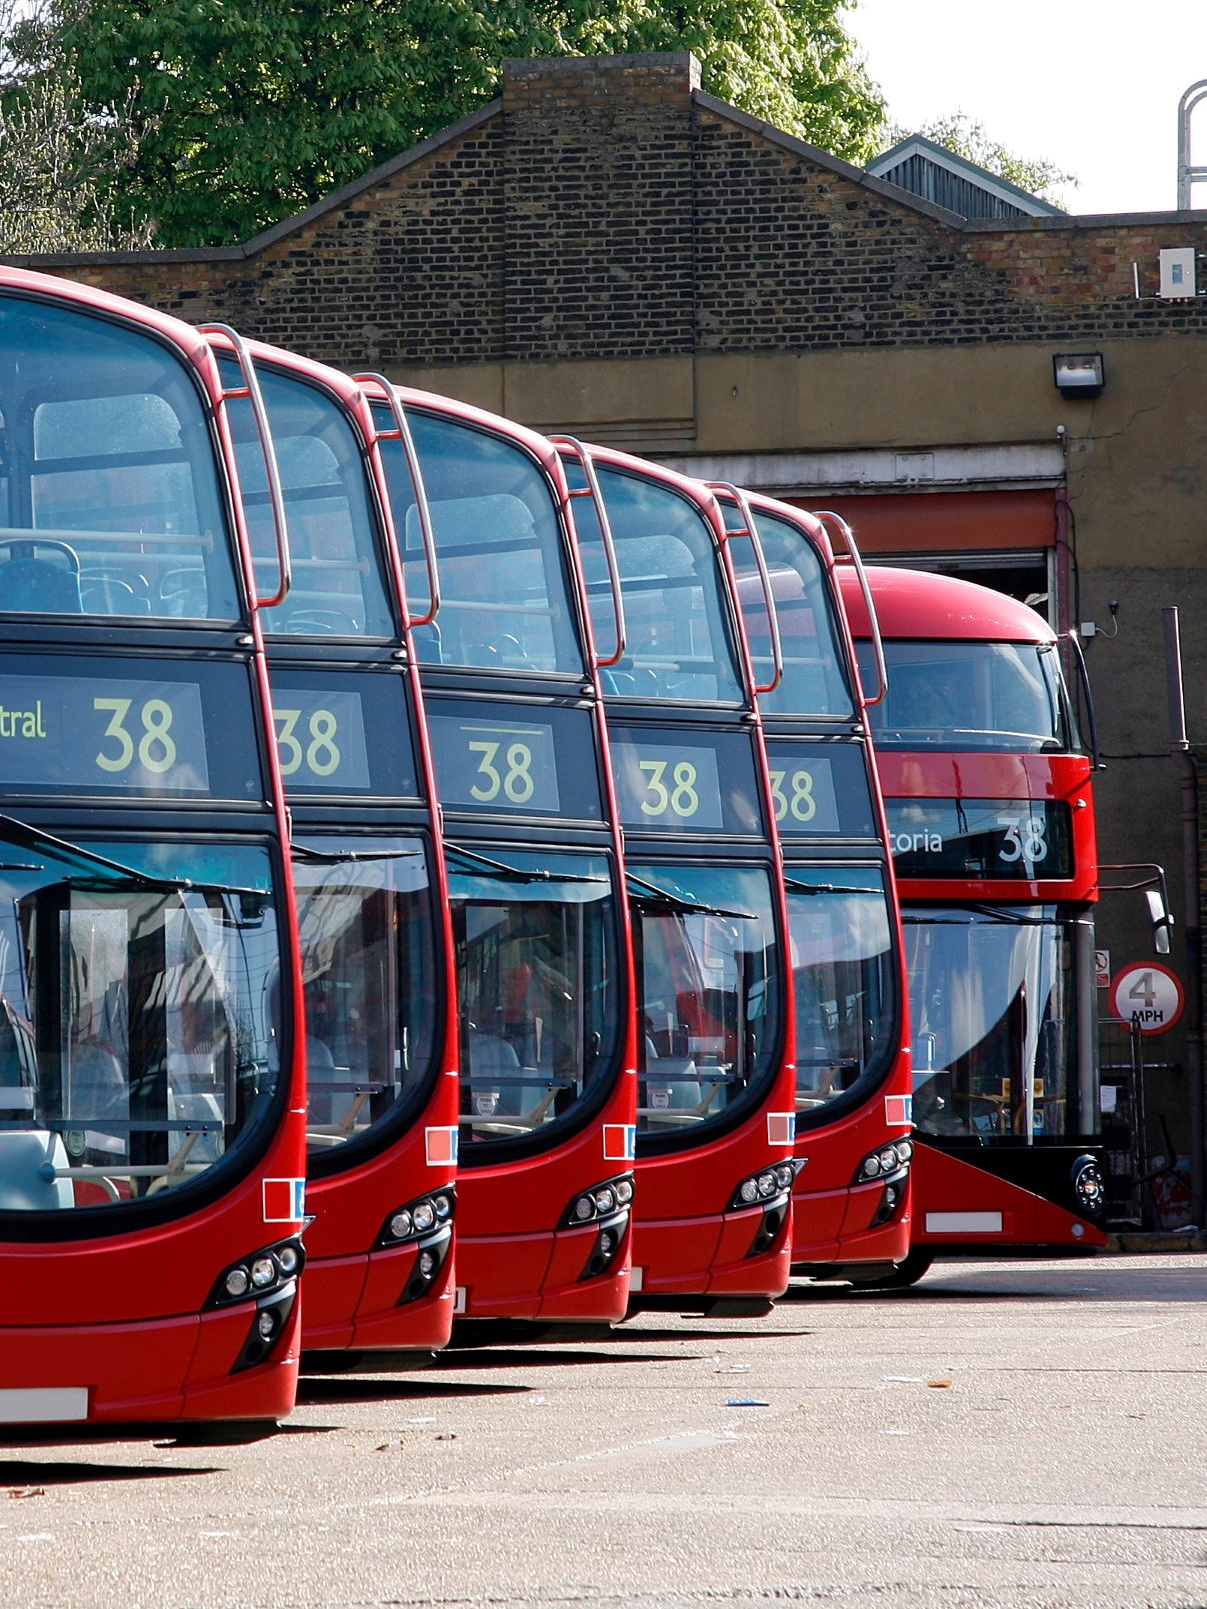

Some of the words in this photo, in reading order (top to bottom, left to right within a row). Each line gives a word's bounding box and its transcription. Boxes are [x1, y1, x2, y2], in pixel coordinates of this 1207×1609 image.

[94, 698, 176, 773] 38
[274, 709, 340, 776] 38
[468, 741, 534, 803] 38
[639, 760, 699, 817] 38
[769, 770, 816, 822] 38
[997, 816, 1048, 862] 38
[1128, 971, 1156, 1008] 4
[1131, 1010, 1164, 1023] MPH
